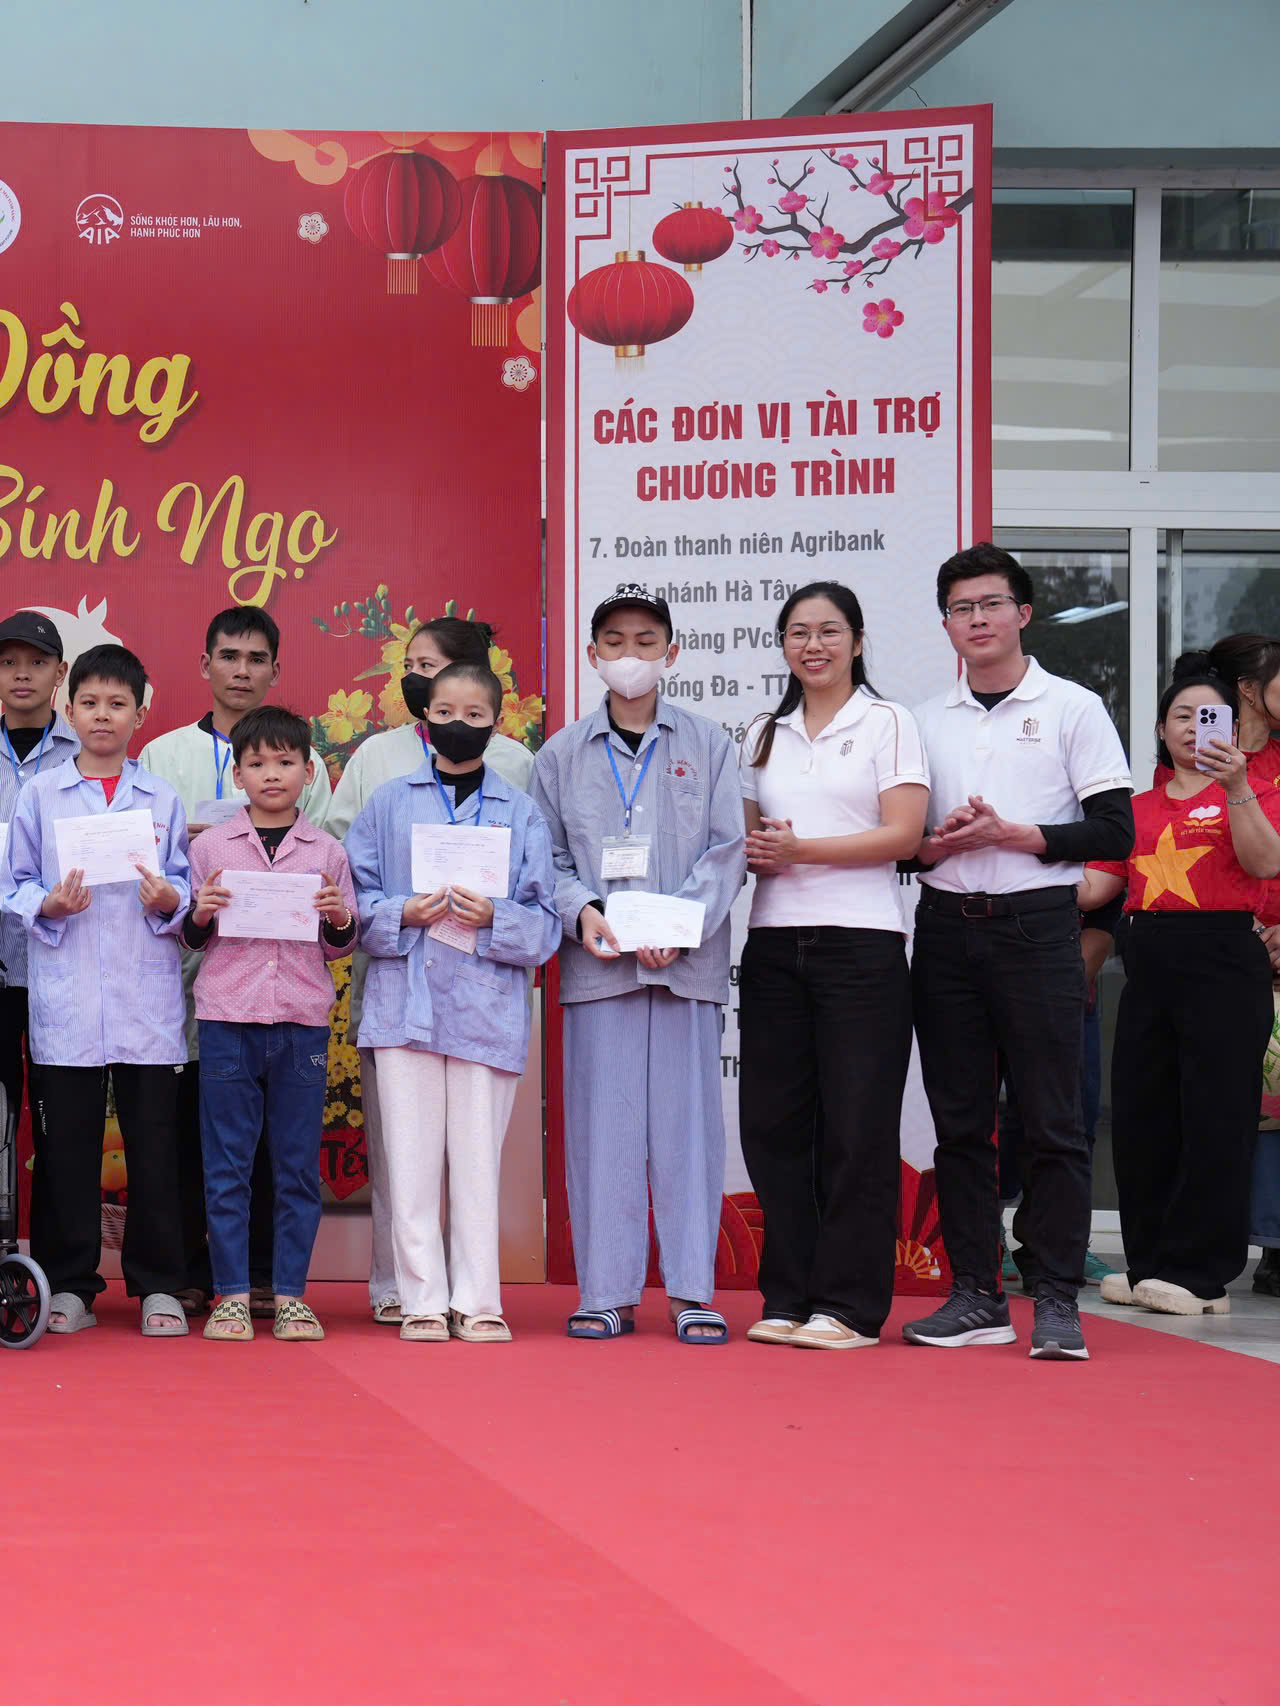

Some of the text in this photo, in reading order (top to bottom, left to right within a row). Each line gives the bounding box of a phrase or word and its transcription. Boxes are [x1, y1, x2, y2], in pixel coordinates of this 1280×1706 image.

[130, 213, 153, 226] SỐNG
[180, 215, 201, 228] HƠN,
[222, 216, 243, 228] HƠN,
[130, 225, 201, 239] HẠNH PHÚC HƠN
[78, 226, 121, 245] AIA
[594, 389, 941, 444] CÁC ĐƠN VỊ TÀI TRỢ
[637, 448, 895, 502] CHƯƠNG TRÌNH
[157, 475, 339, 608] Ngọ
[589, 529, 886, 558] 7. Đoàn thanh niên Agribank
[725, 579, 753, 602] Hà
[710, 675, 739, 698] Đa
